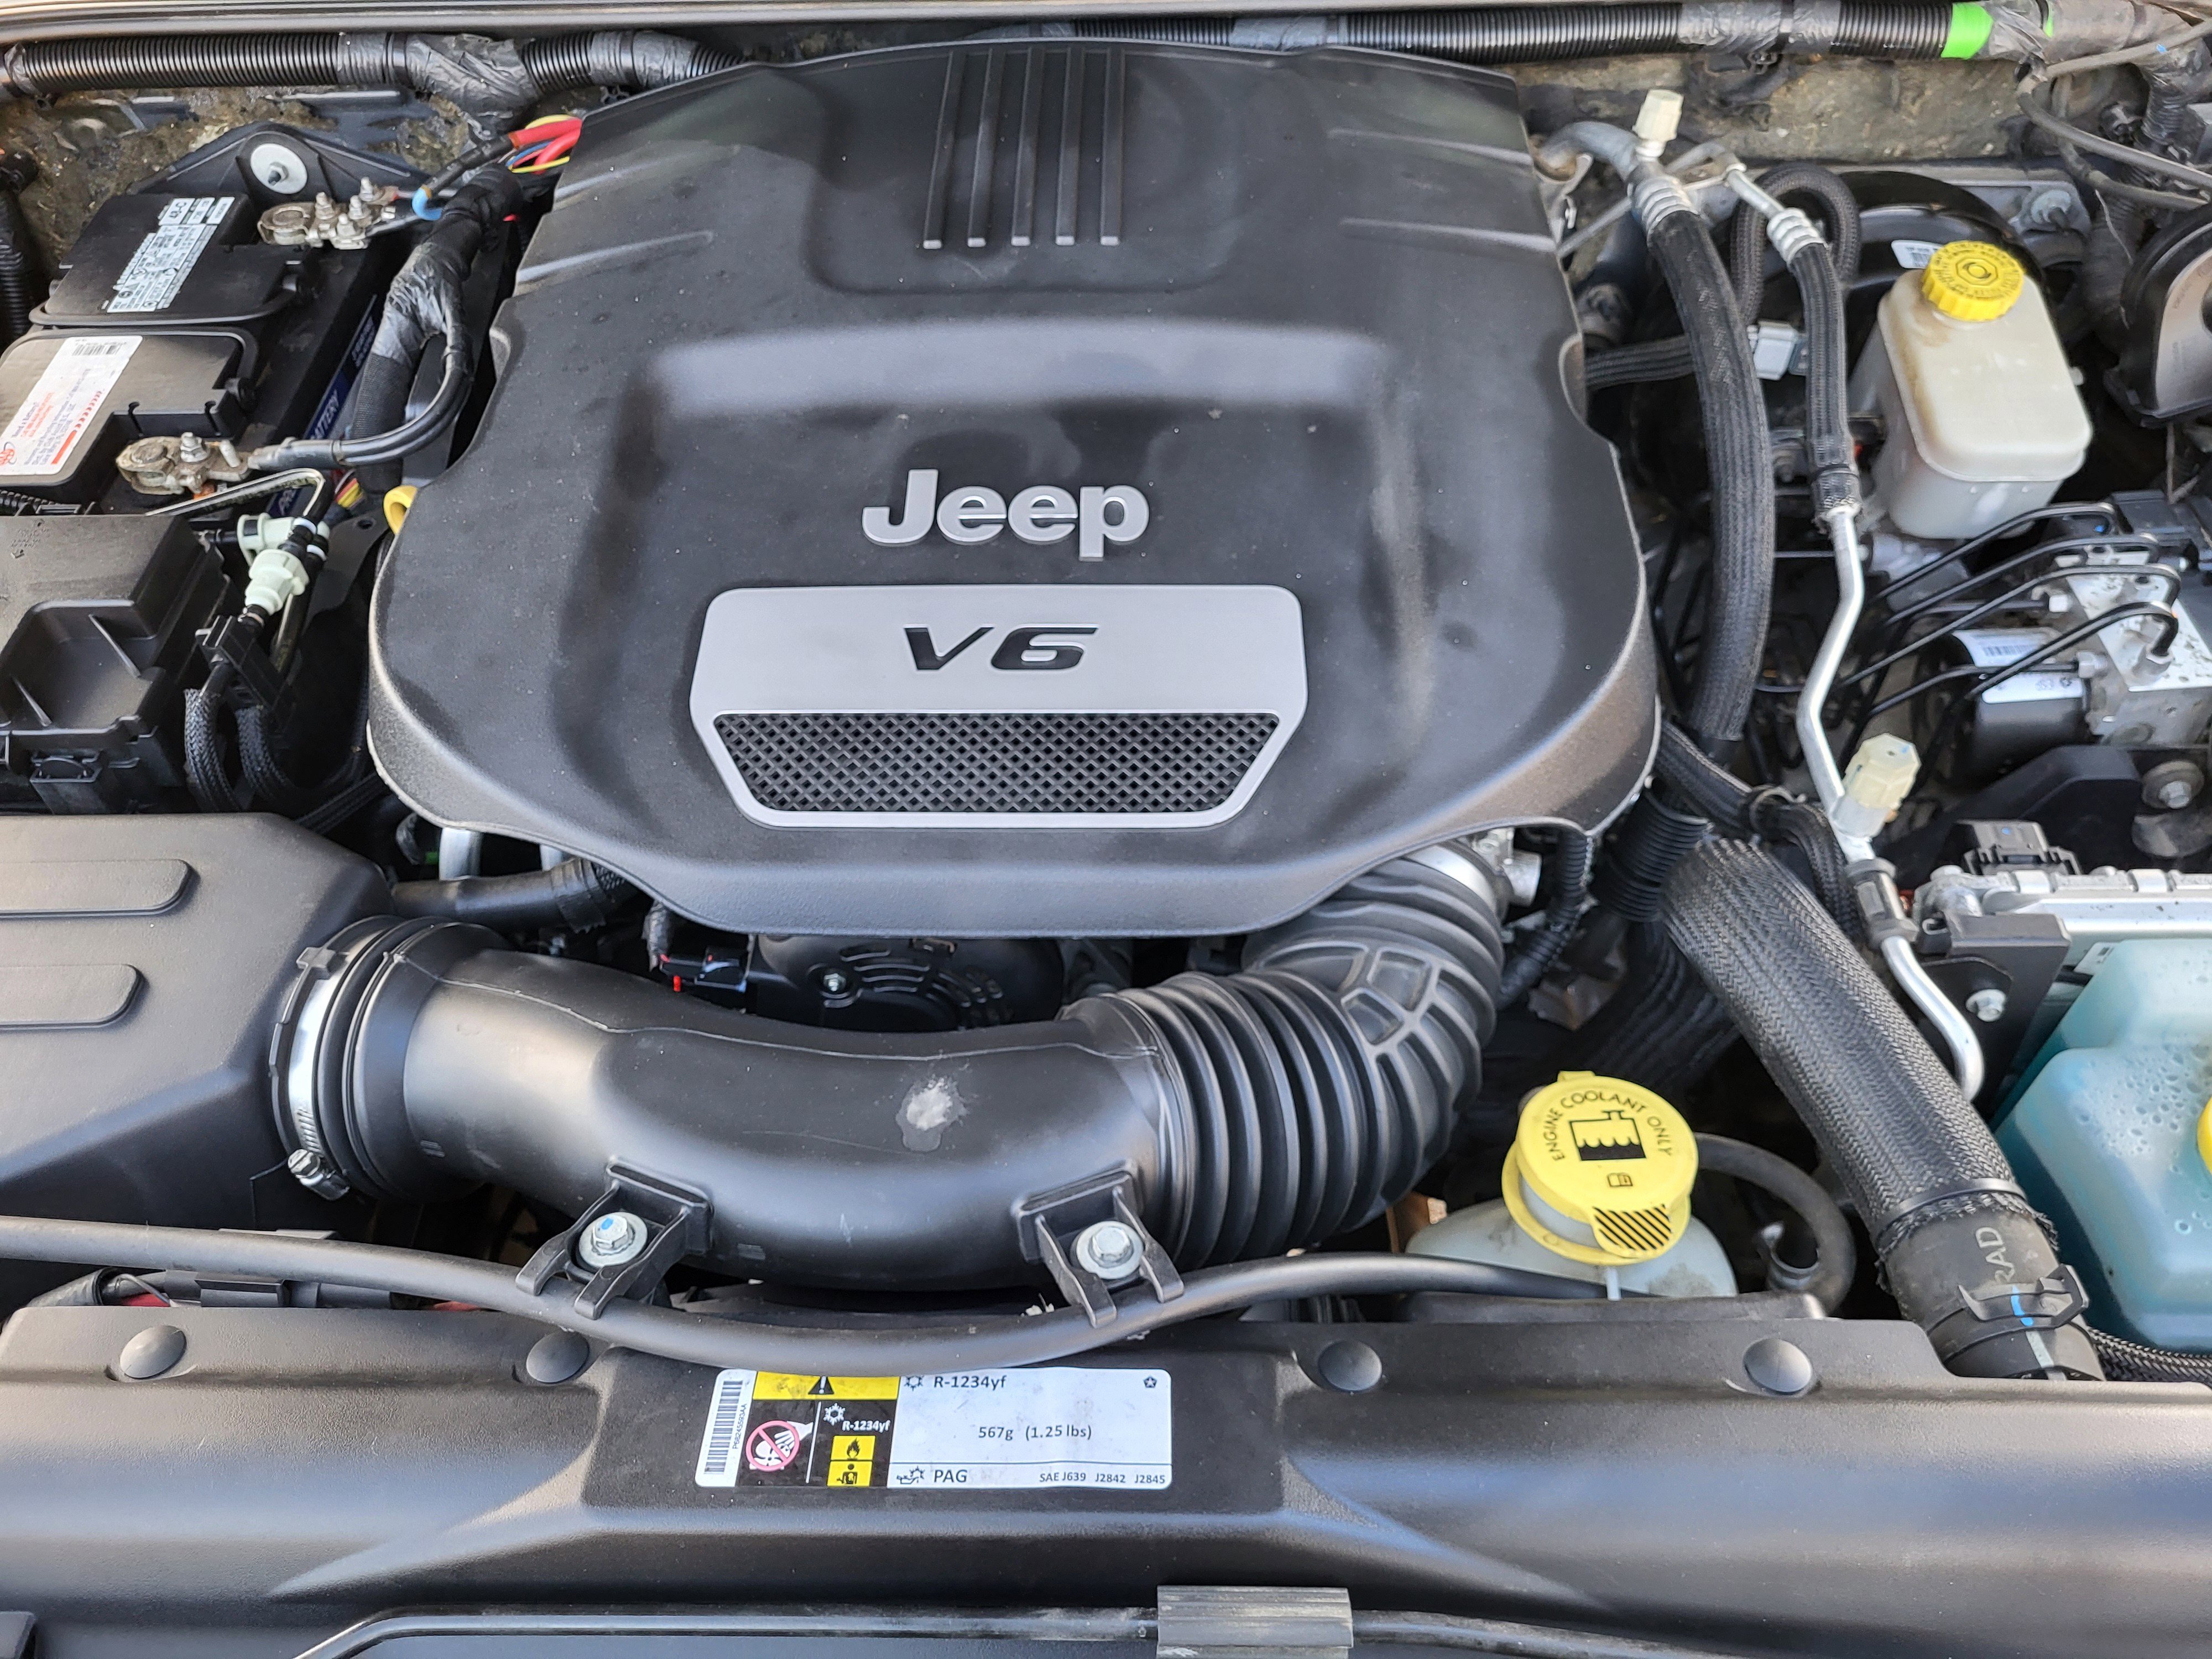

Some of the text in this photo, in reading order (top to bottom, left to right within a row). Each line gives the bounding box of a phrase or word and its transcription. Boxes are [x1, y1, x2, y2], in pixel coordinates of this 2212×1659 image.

[862, 469, 1149, 561] Jeep
[904, 625, 1098, 670] V6
[1542, 1090, 1673, 1161] ENGINE COOLANT ONLY
[933, 1375, 1006, 1390] R-1234yf
[842, 1420, 891, 1433] R-1234yf
[978, 1425, 1092, 1441] 567g (1.25 lbs)
[933, 1469, 968, 1483] PAG
[1039, 1473, 1165, 1484] SAE J639 J2842 J2845
